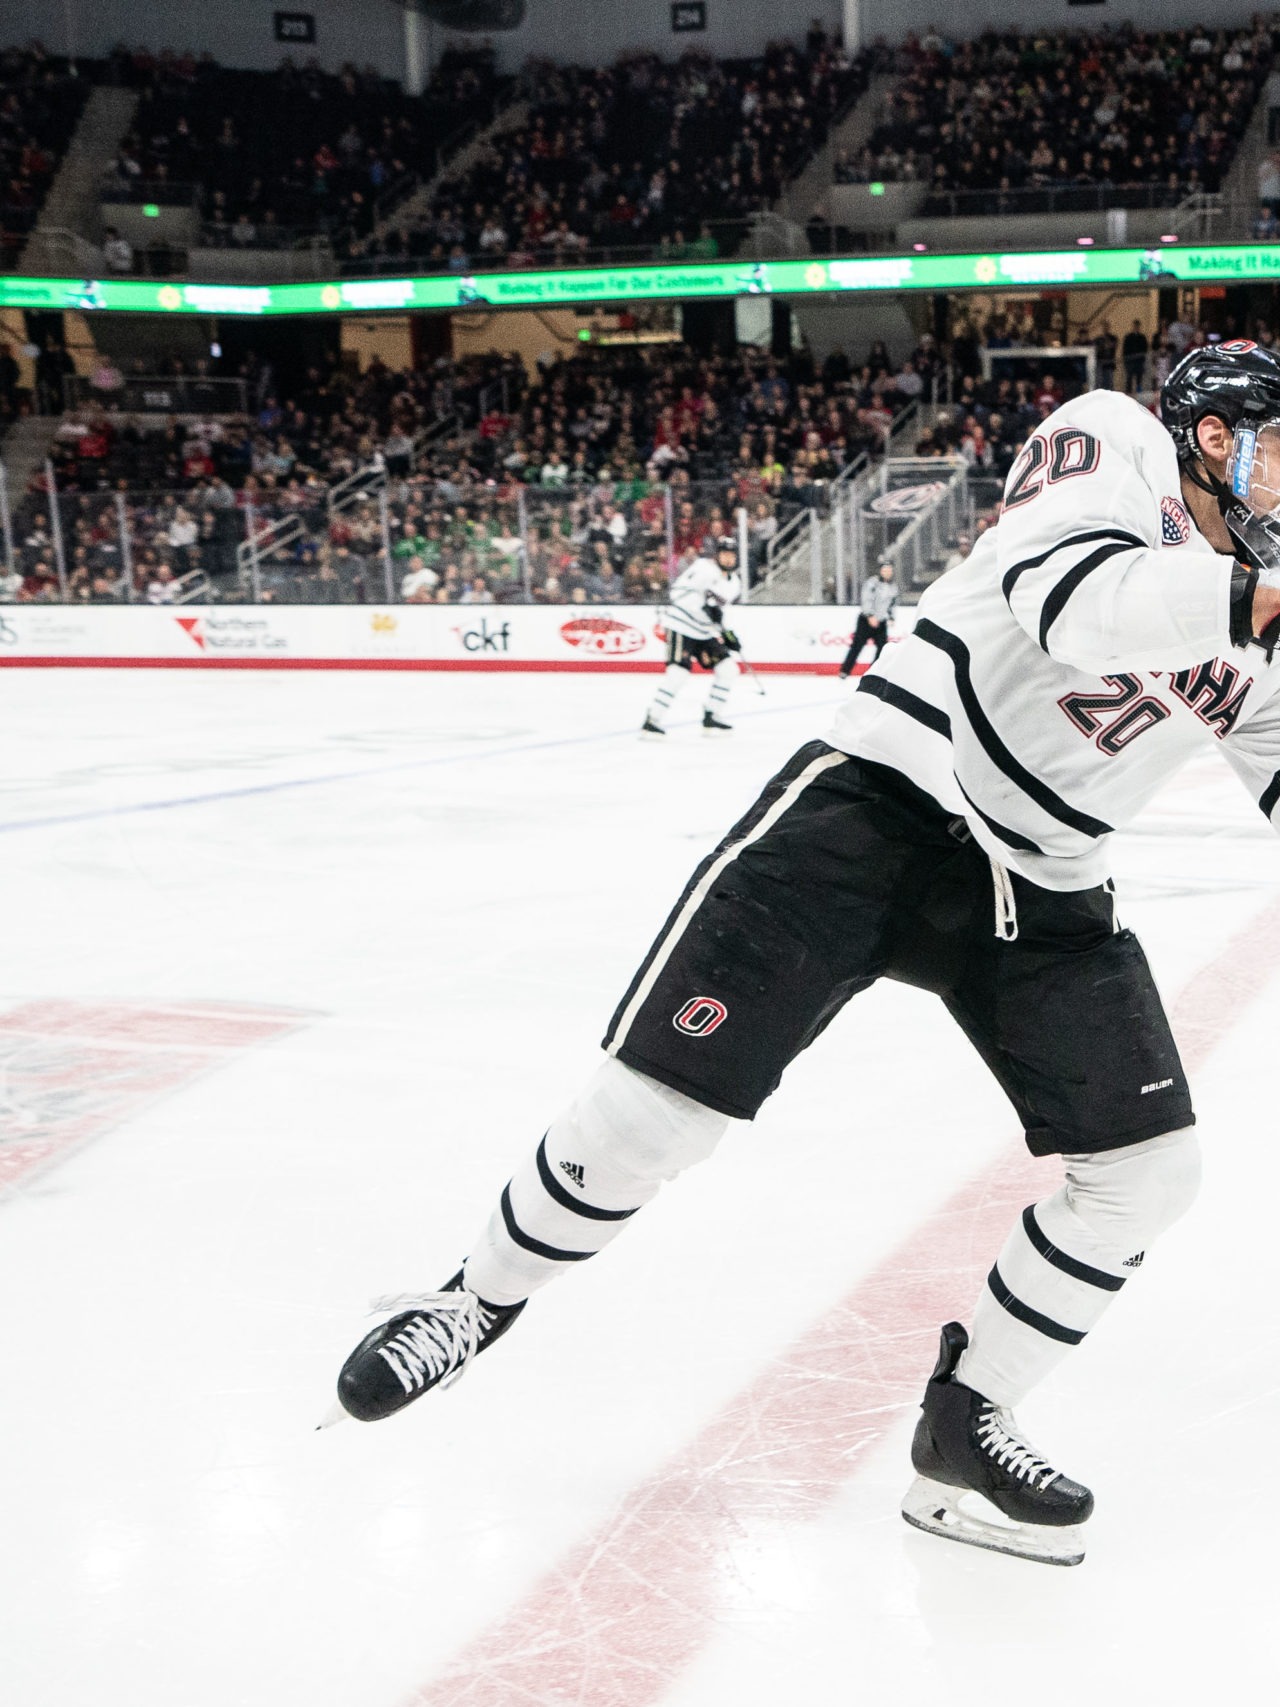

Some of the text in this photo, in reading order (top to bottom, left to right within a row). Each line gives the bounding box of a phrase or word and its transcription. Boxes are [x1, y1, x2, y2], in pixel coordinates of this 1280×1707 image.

[1188, 255, 1242, 273] Making
[1001, 427, 1101, 515] 20
[1237, 432, 1254, 496] BAUER
[205, 616, 268, 631] Northern
[463, 617, 512, 652] ckf
[206, 634, 288, 649] Natural Gas
[1056, 671, 1172, 757] 20
[1140, 1077, 1174, 1095] BAUER
